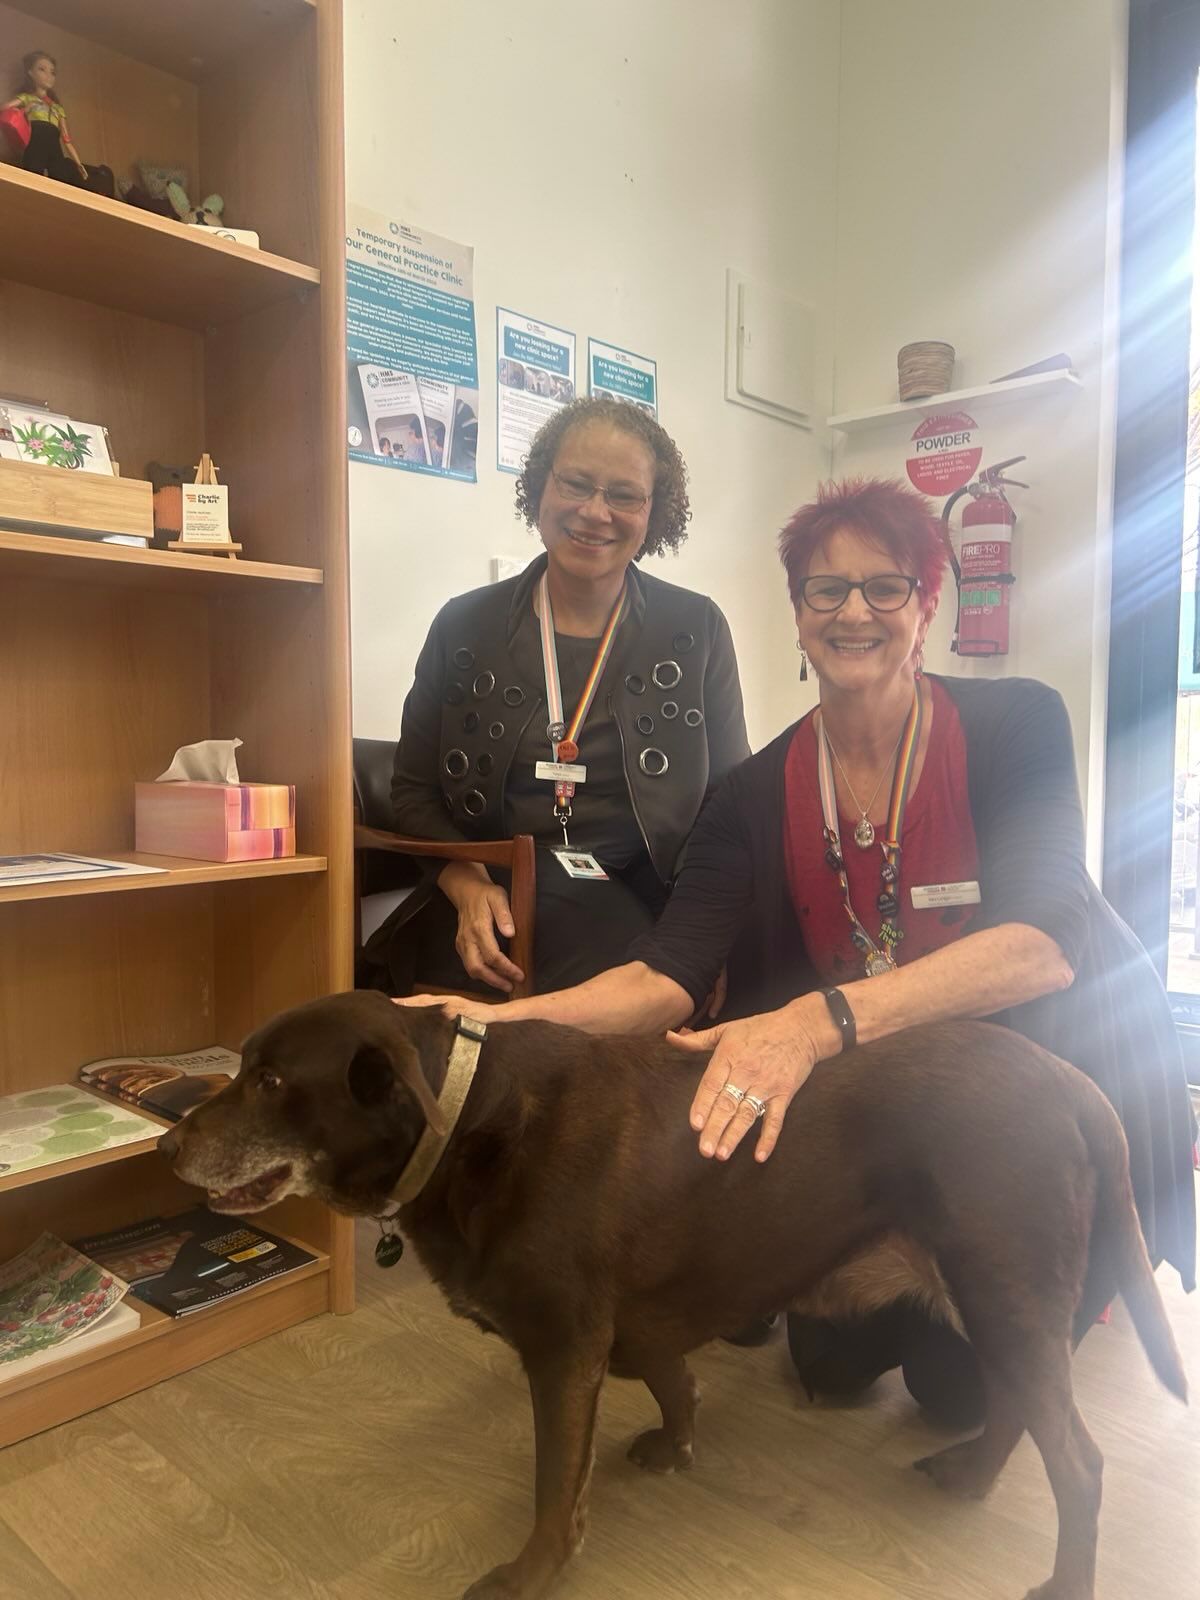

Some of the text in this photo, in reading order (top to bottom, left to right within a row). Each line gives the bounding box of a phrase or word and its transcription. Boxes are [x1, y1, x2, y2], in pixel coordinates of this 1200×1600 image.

[356, 228, 401, 252] Temporary
[402, 245, 444, 267] Suspension
[444, 261, 453, 269] of
[345, 237, 363, 250] Our
[365, 244, 402, 263] General
[403, 258, 439, 278] Practice
[440, 272, 463, 286] Clinic
[509, 331, 520, 340] Are
[520, 335, 530, 344] you
[531, 338, 551, 352] looking
[551, 345, 559, 353] for
[514, 342, 526, 351] new
[526, 346, 541, 356] clinic
[540, 351, 559, 361] space?
[381, 375, 409, 383] COMMUNITY
[598, 360, 608, 369] Are
[608, 364, 618, 372] you
[618, 367, 636, 380] looking
[636, 373, 645, 381] for
[603, 371, 645, 388] new clinic space?
[420, 378, 448, 390] COMMUNITY
[916, 432, 971, 452] POWDER
[881, 923, 897, 938] she
